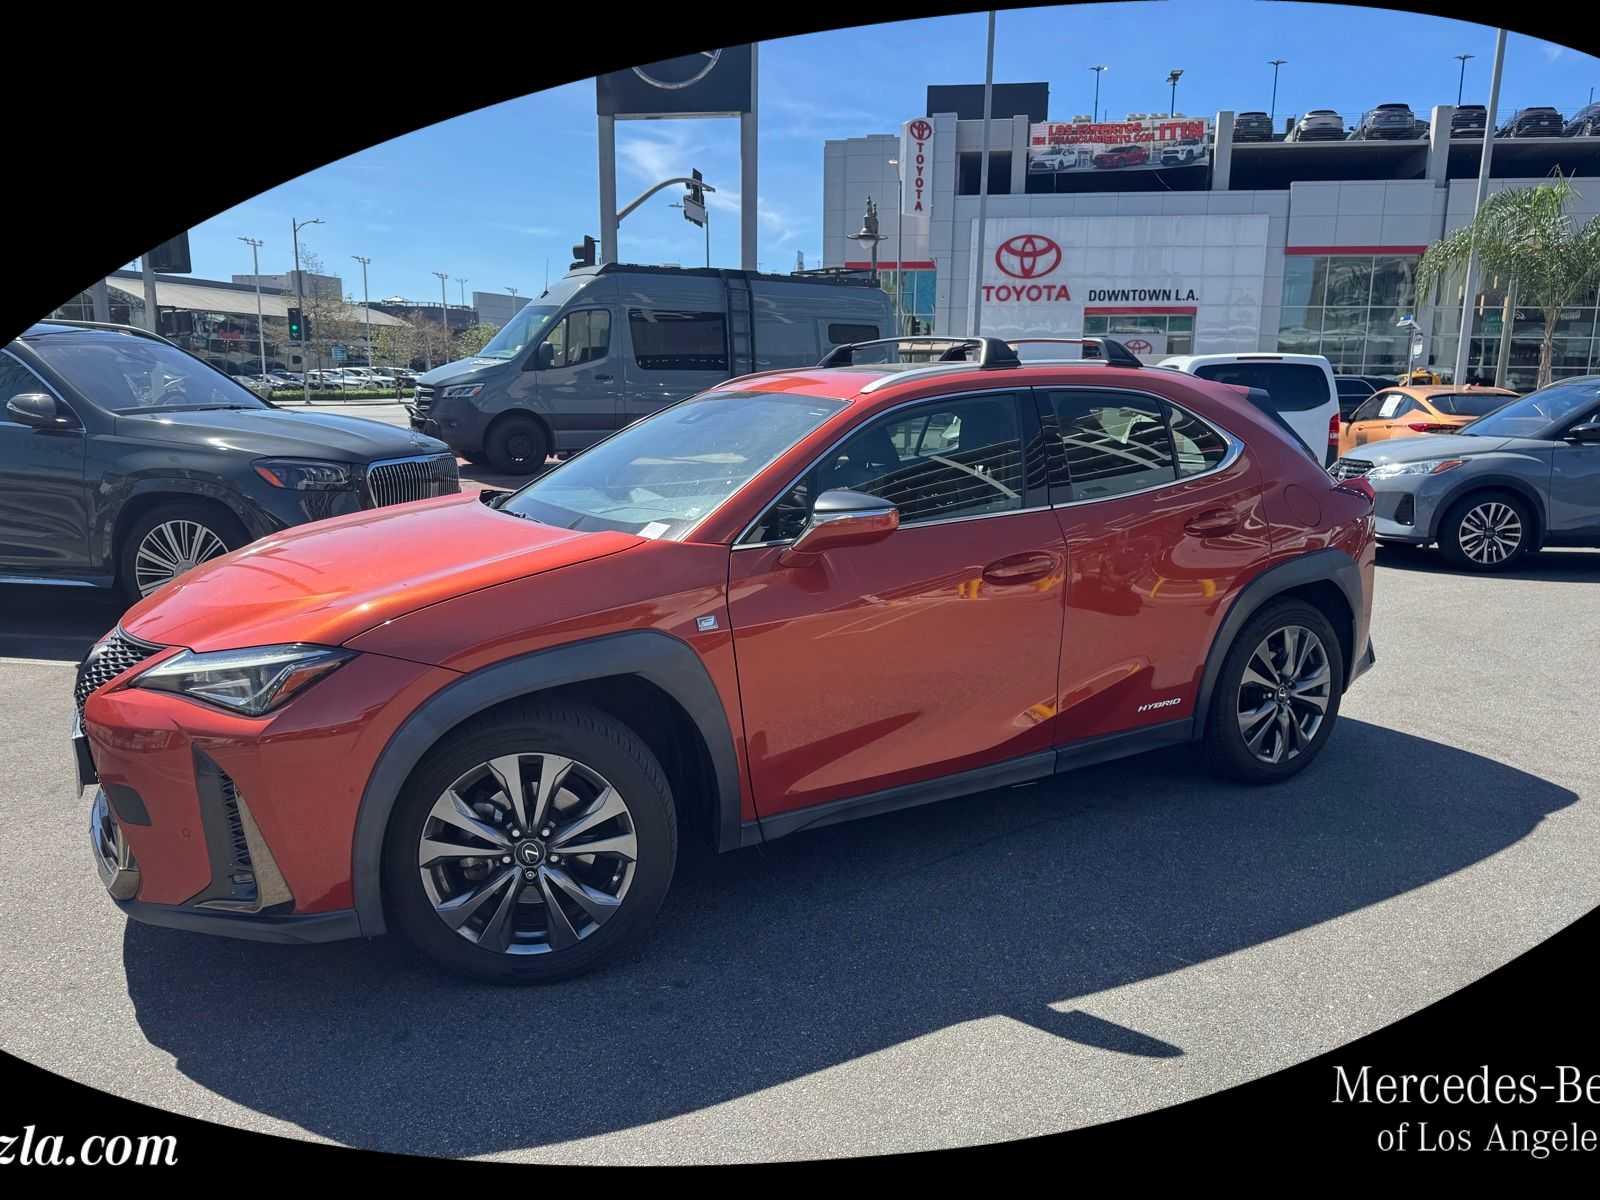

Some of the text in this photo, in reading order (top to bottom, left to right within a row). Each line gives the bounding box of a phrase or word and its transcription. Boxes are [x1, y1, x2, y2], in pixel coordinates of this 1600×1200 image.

[914, 142, 924, 211] TOYOTA
[982, 284, 1071, 302] TOYOTA
[1088, 289, 1199, 302] DOWNTOWN L.A.
[1137, 697, 1182, 713] HYBRID
